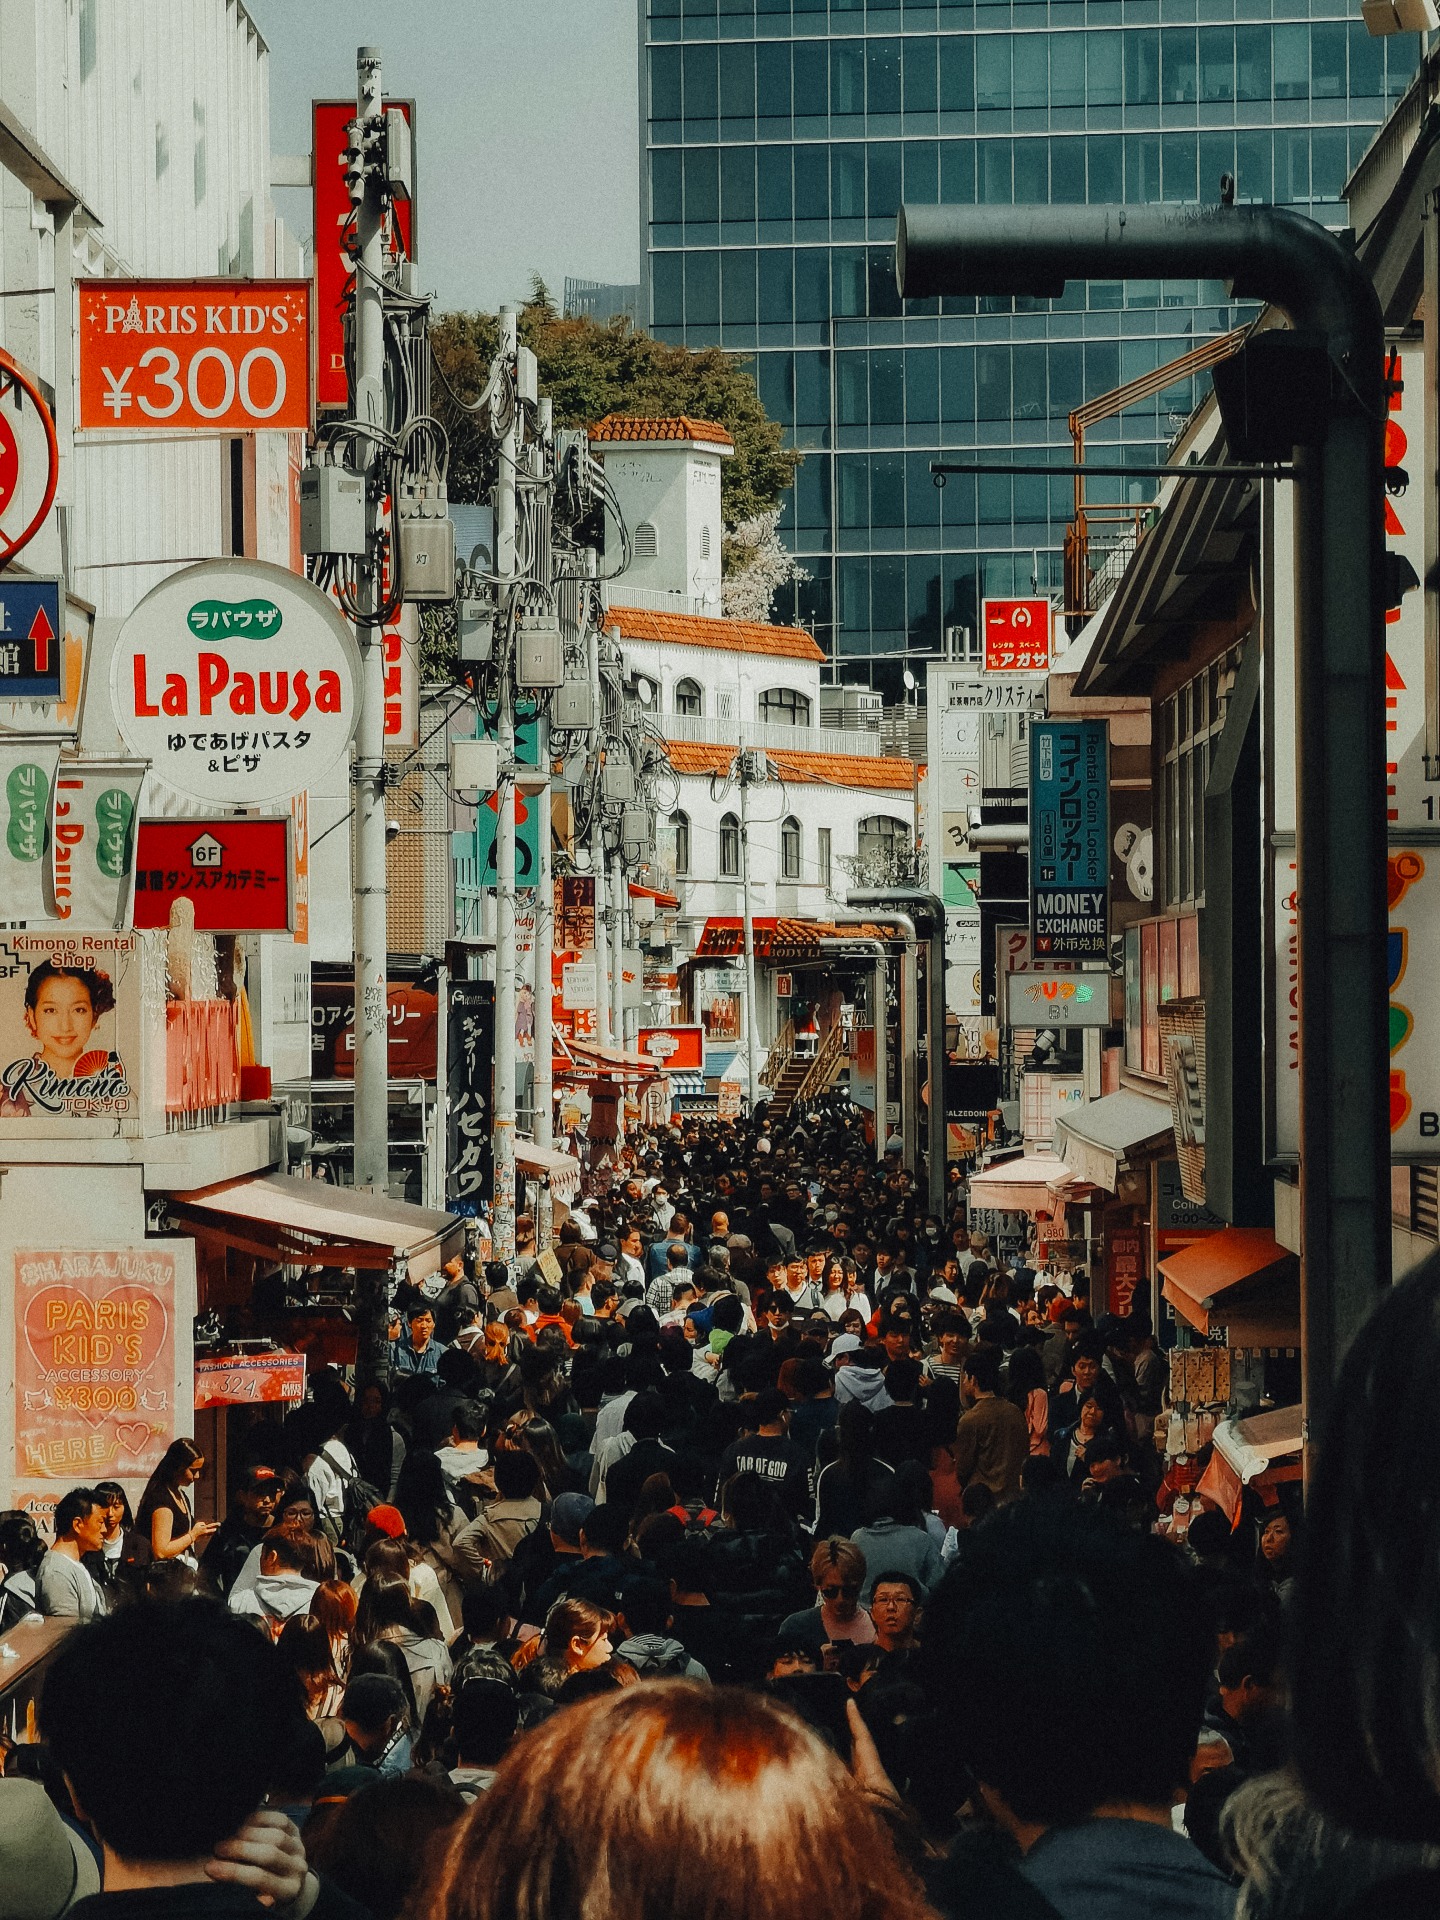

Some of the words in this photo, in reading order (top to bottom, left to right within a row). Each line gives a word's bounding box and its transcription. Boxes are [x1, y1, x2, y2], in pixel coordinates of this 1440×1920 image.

[104, 295, 198, 334] PARIS
[203, 305, 289, 334] KID'S
[100, 346, 287, 419] ¥300
[190, 608, 279, 629] ラパウザ
[1000, 651, 1048, 668] アガサ
[133, 653, 188, 718] La
[197, 652, 342, 722] Pausa
[951, 682, 966, 691] 1F
[984, 685, 1044, 708] クリスティー
[167, 730, 312, 751] ゆであげパスタ
[207, 753, 262, 773] &ピザ
[1086, 733, 1100, 784] Rental
[18, 767, 38, 860] ラパウザ
[1059, 734, 1082, 882] コインロッカー
[1086, 788, 1100, 824] Coin
[106, 792, 125, 876] ラパウザ
[195, 846, 218, 862] 6F
[1086, 828, 1100, 882] Locker
[1041, 868, 1055, 880] 1F
[1037, 893, 1104, 915] MONEY
[1036, 918, 1105, 934] EXCHANGE
[12, 935, 78, 951] Kimono
[82, 936, 135, 951] Rental
[51, 952, 96, 971] Shop
[462, 1014, 483, 1086] ギャラリー
[2, 1057, 129, 1113] Kimono
[61, 1097, 130, 1112] TOKYO
[451, 1091, 489, 1198] ハセガワ
[46, 1299, 151, 1331] PARIS
[53, 1333, 143, 1365] KID'S
[238, 1357, 299, 1368] ACCESSORIES
[53, 1384, 138, 1411] ¥300
[25, 1434, 106, 1466] HERE
[767, 1459, 788, 1478] GOD
